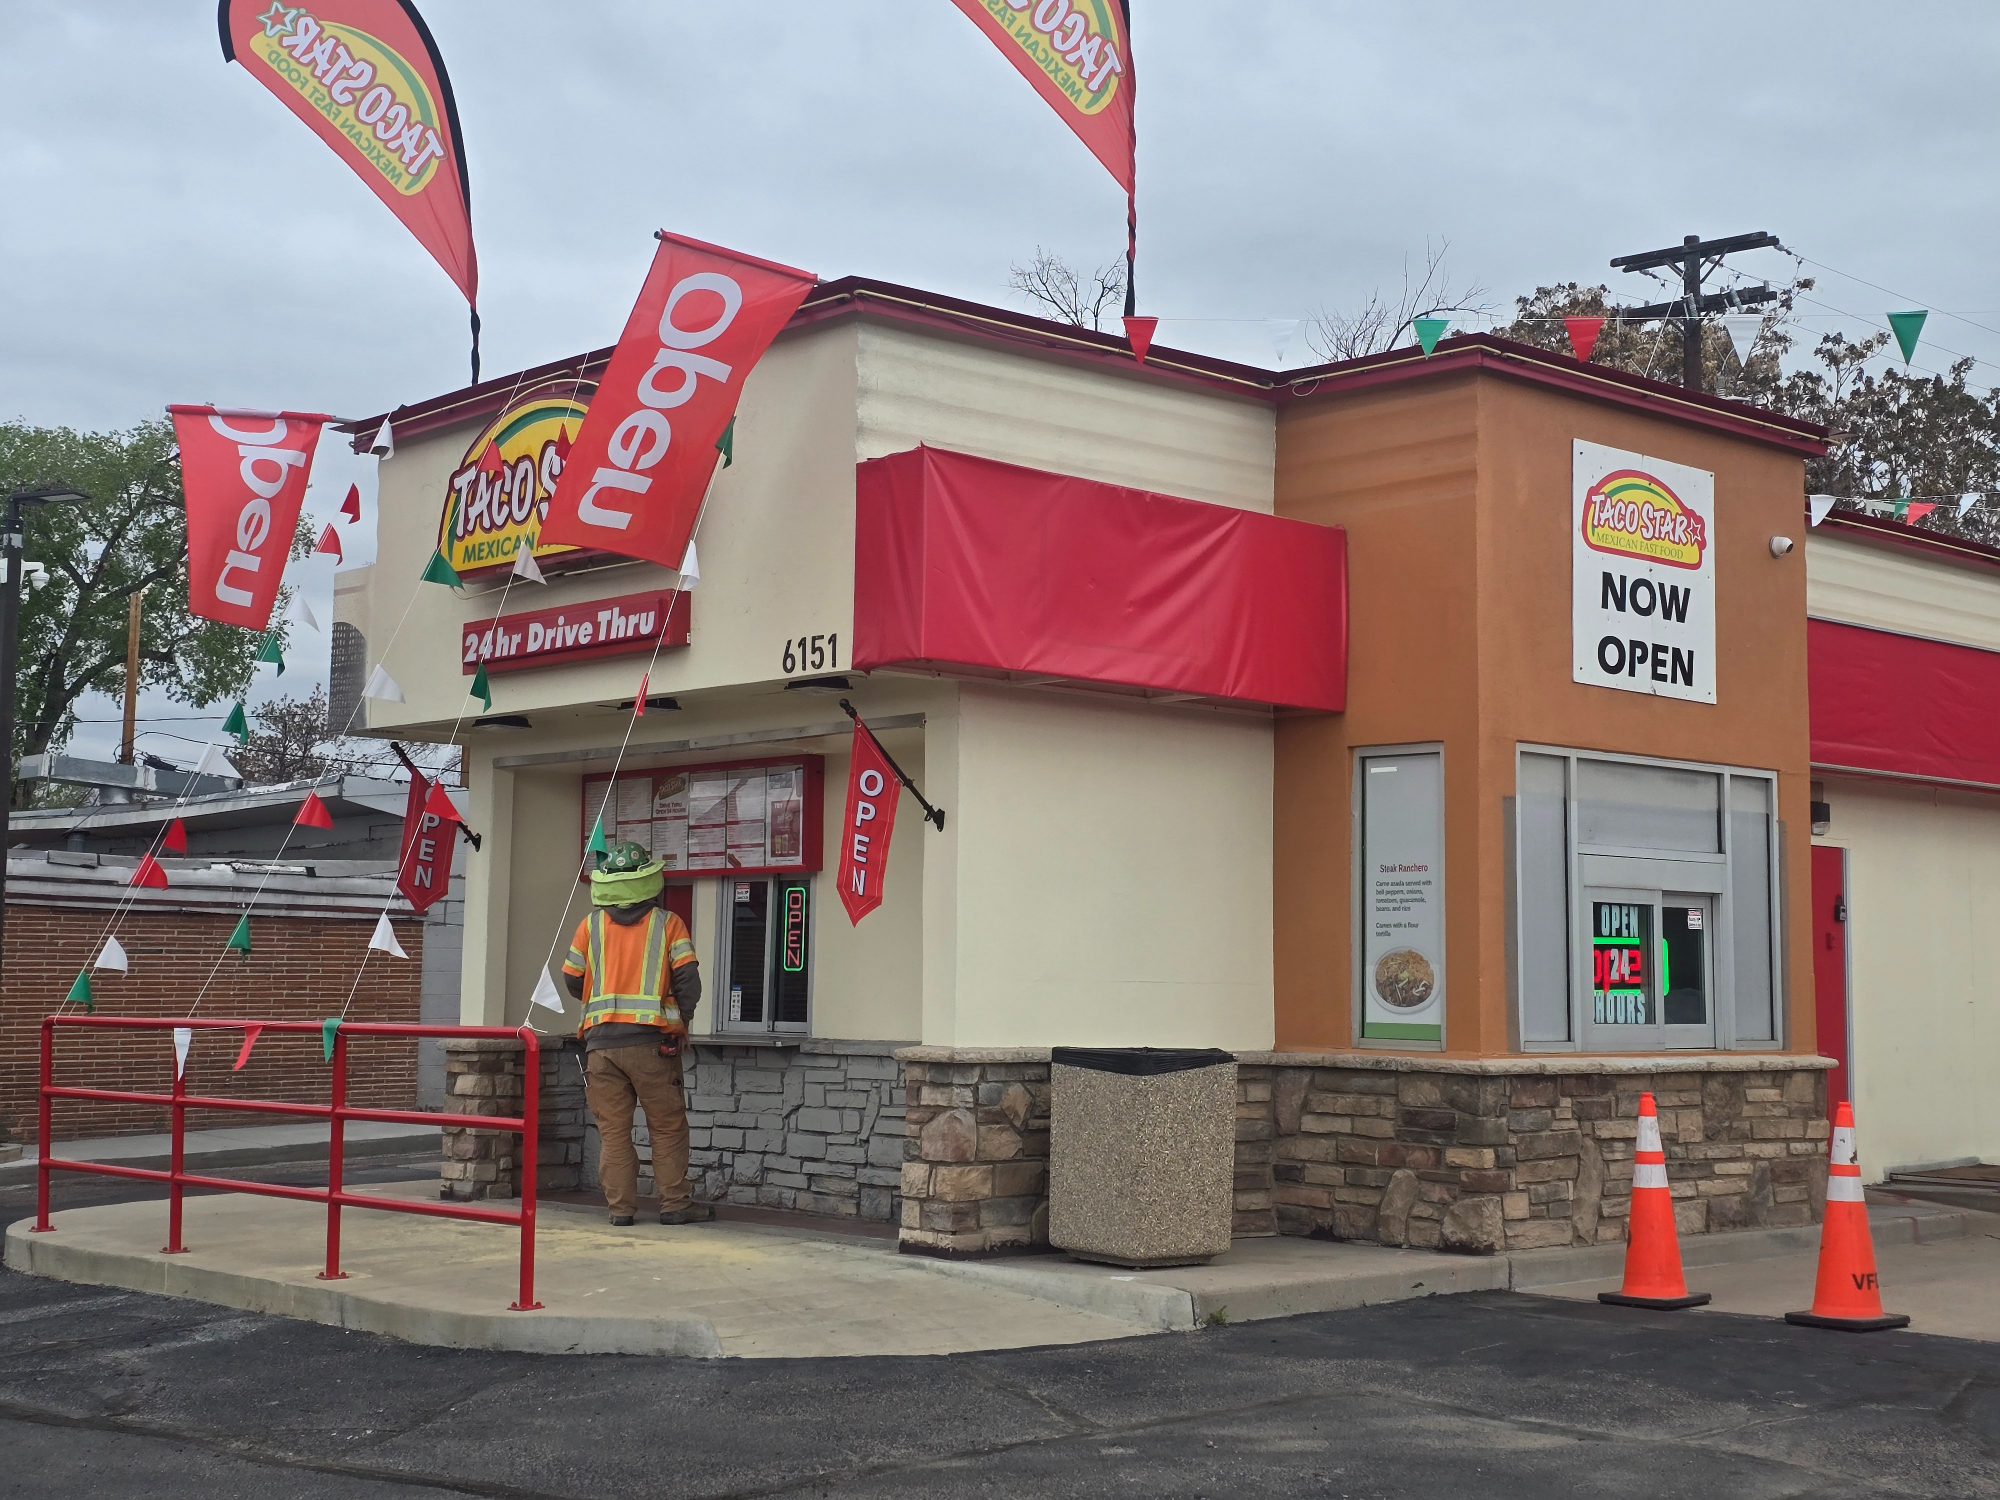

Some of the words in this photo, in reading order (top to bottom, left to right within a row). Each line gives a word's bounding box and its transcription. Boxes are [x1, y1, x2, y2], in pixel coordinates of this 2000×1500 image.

[453, 460, 534, 537] TACO
[1592, 495, 1638, 533] TACO
[1641, 503, 1688, 543] STAR
[463, 531, 536, 564] MEXICAN
[1596, 531, 1638, 551] MEXICAN
[1639, 541, 1659, 556] FAST
[1660, 545, 1683, 560] FOOD
[1601, 571, 1691, 624] NOW
[463, 626, 523, 663] 24hr
[527, 615, 593, 653] Drive
[598, 607, 655, 641] Thru
[782, 633, 837, 674] 6151
[1597, 635, 1694, 687] OPEN
[413, 786, 441, 889] PEN
[851, 769, 885, 896] OPEN
[1380, 863, 1397, 873] Steak
[1398, 863, 1428, 873] Ranchero
[787, 893, 802, 966] OPEN
[1601, 905, 1638, 937] OPEN
[1610, 948, 1630, 981] 24
[1594, 992, 1645, 1024] HOURS
